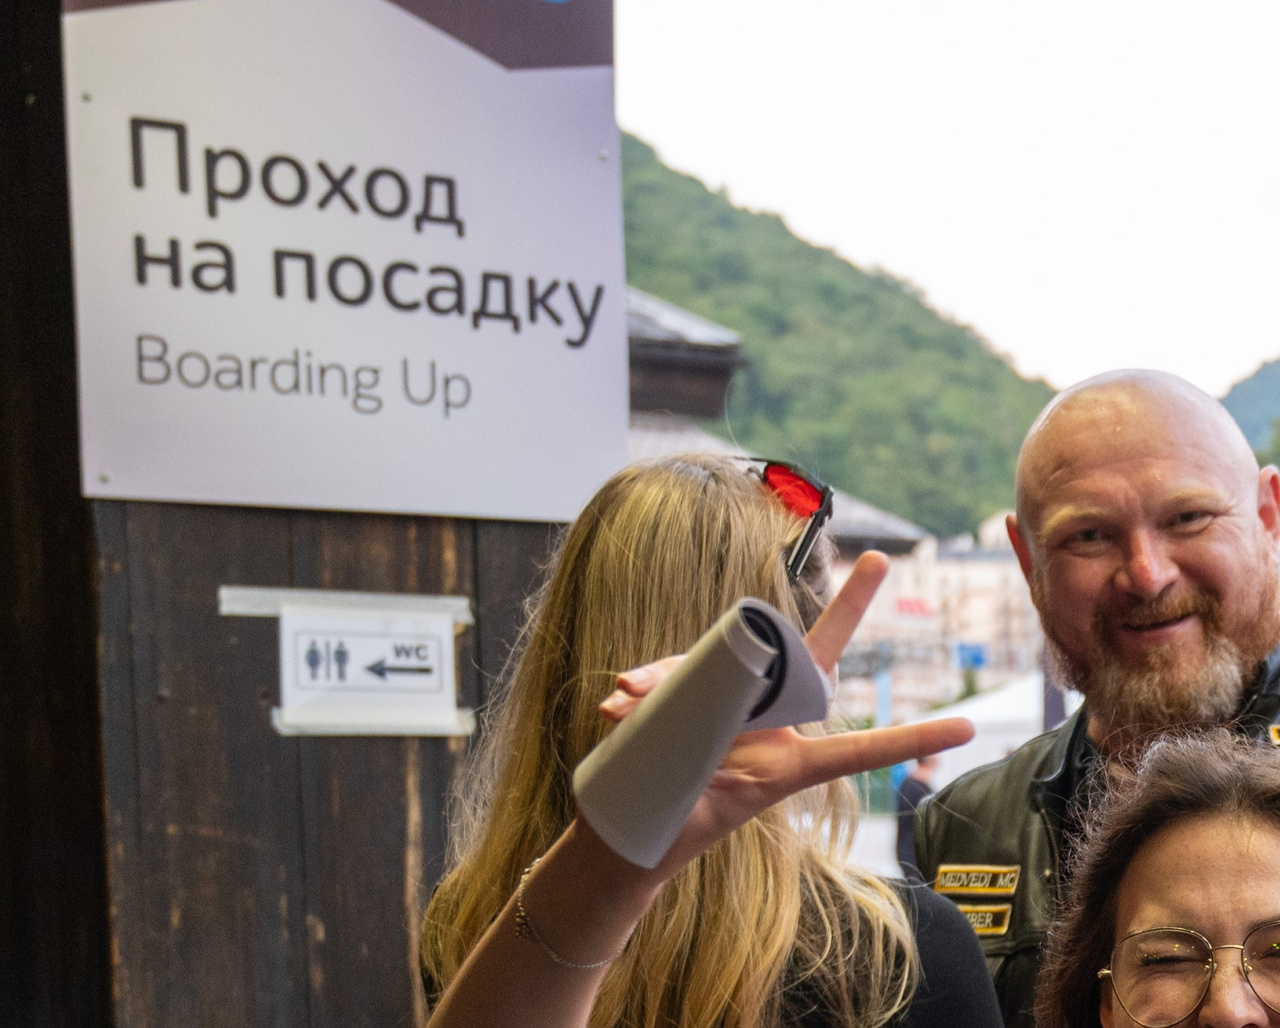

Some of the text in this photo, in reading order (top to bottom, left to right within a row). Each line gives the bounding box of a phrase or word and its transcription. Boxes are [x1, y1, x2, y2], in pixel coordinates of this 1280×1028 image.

[129, 116, 465, 238] Проход
[133, 233, 605, 348] на посадку
[135, 334, 472, 418] Boarding Up
[393, 643, 428, 661] WC
[939, 873, 1016, 888] MEDVEDI MC
